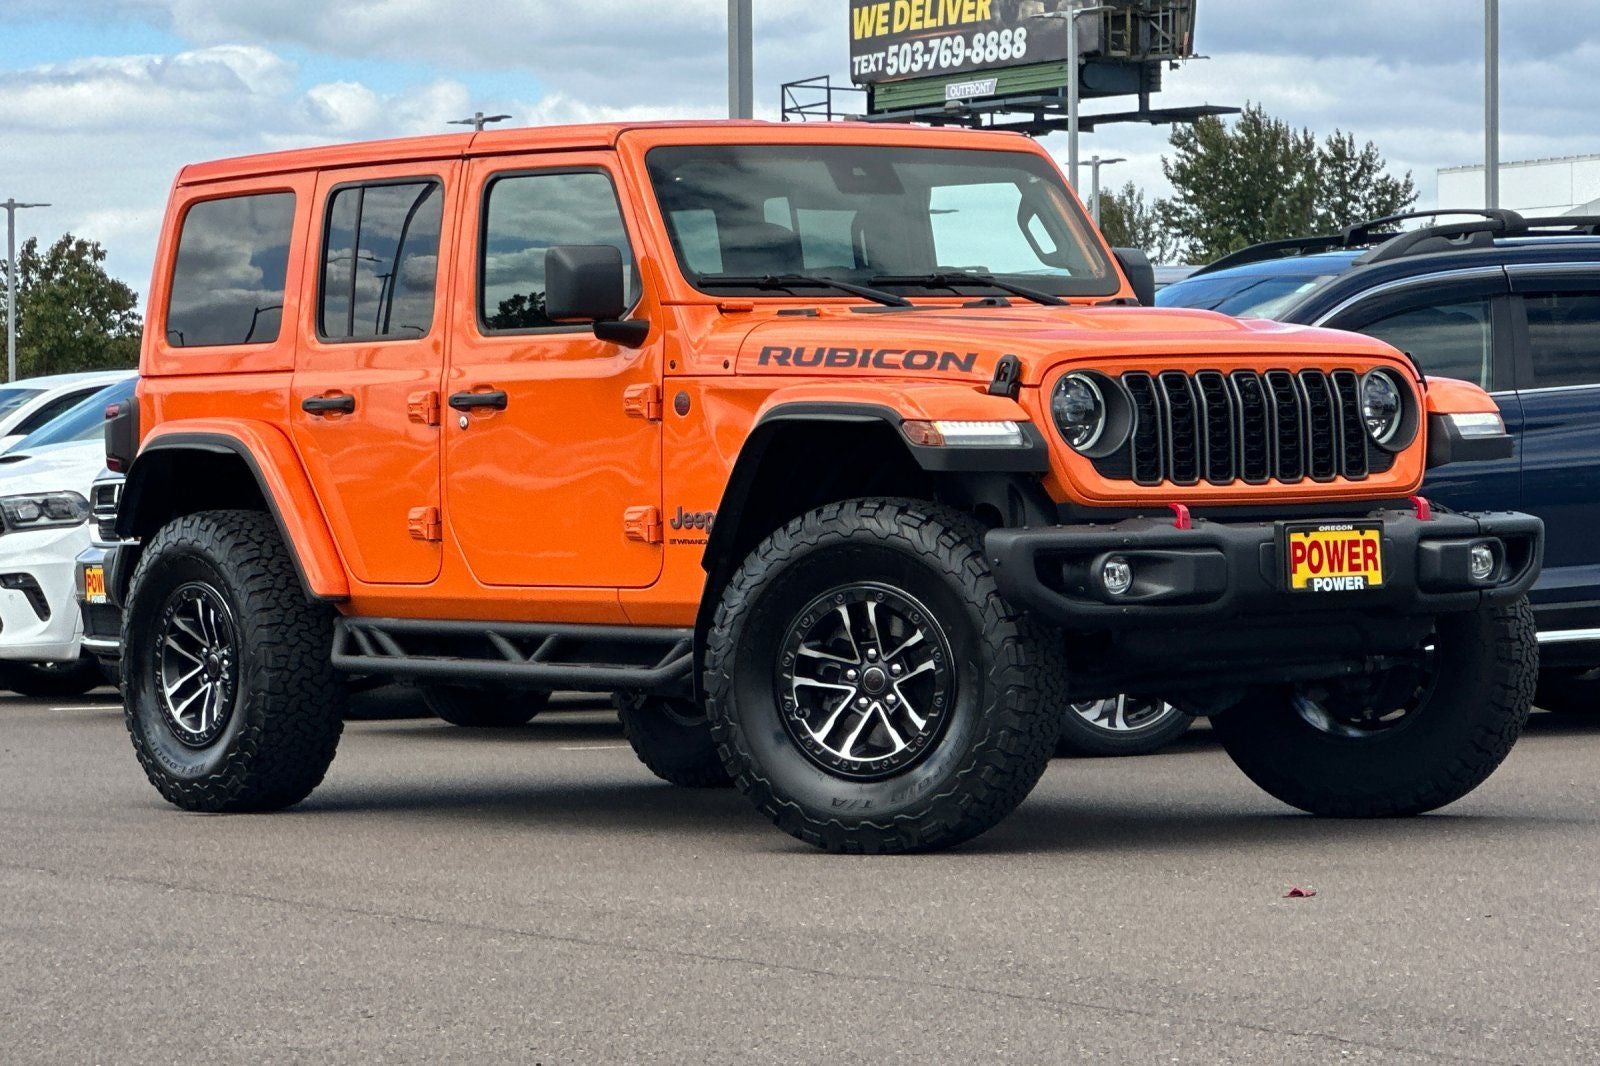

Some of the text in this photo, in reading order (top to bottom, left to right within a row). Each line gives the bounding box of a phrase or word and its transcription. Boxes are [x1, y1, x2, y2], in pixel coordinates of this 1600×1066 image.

[853, 0, 992, 40] WE DELIVER
[852, 27, 1027, 76] TEXT 503-769-8888
[950, 81, 992, 96] OUTFRONT
[758, 346, 978, 372] RUBICON
[670, 506, 715, 534] Jeep
[1291, 539, 1379, 574] POWER
[87, 574, 103, 593] POW
[1313, 577, 1364, 592] POWER
